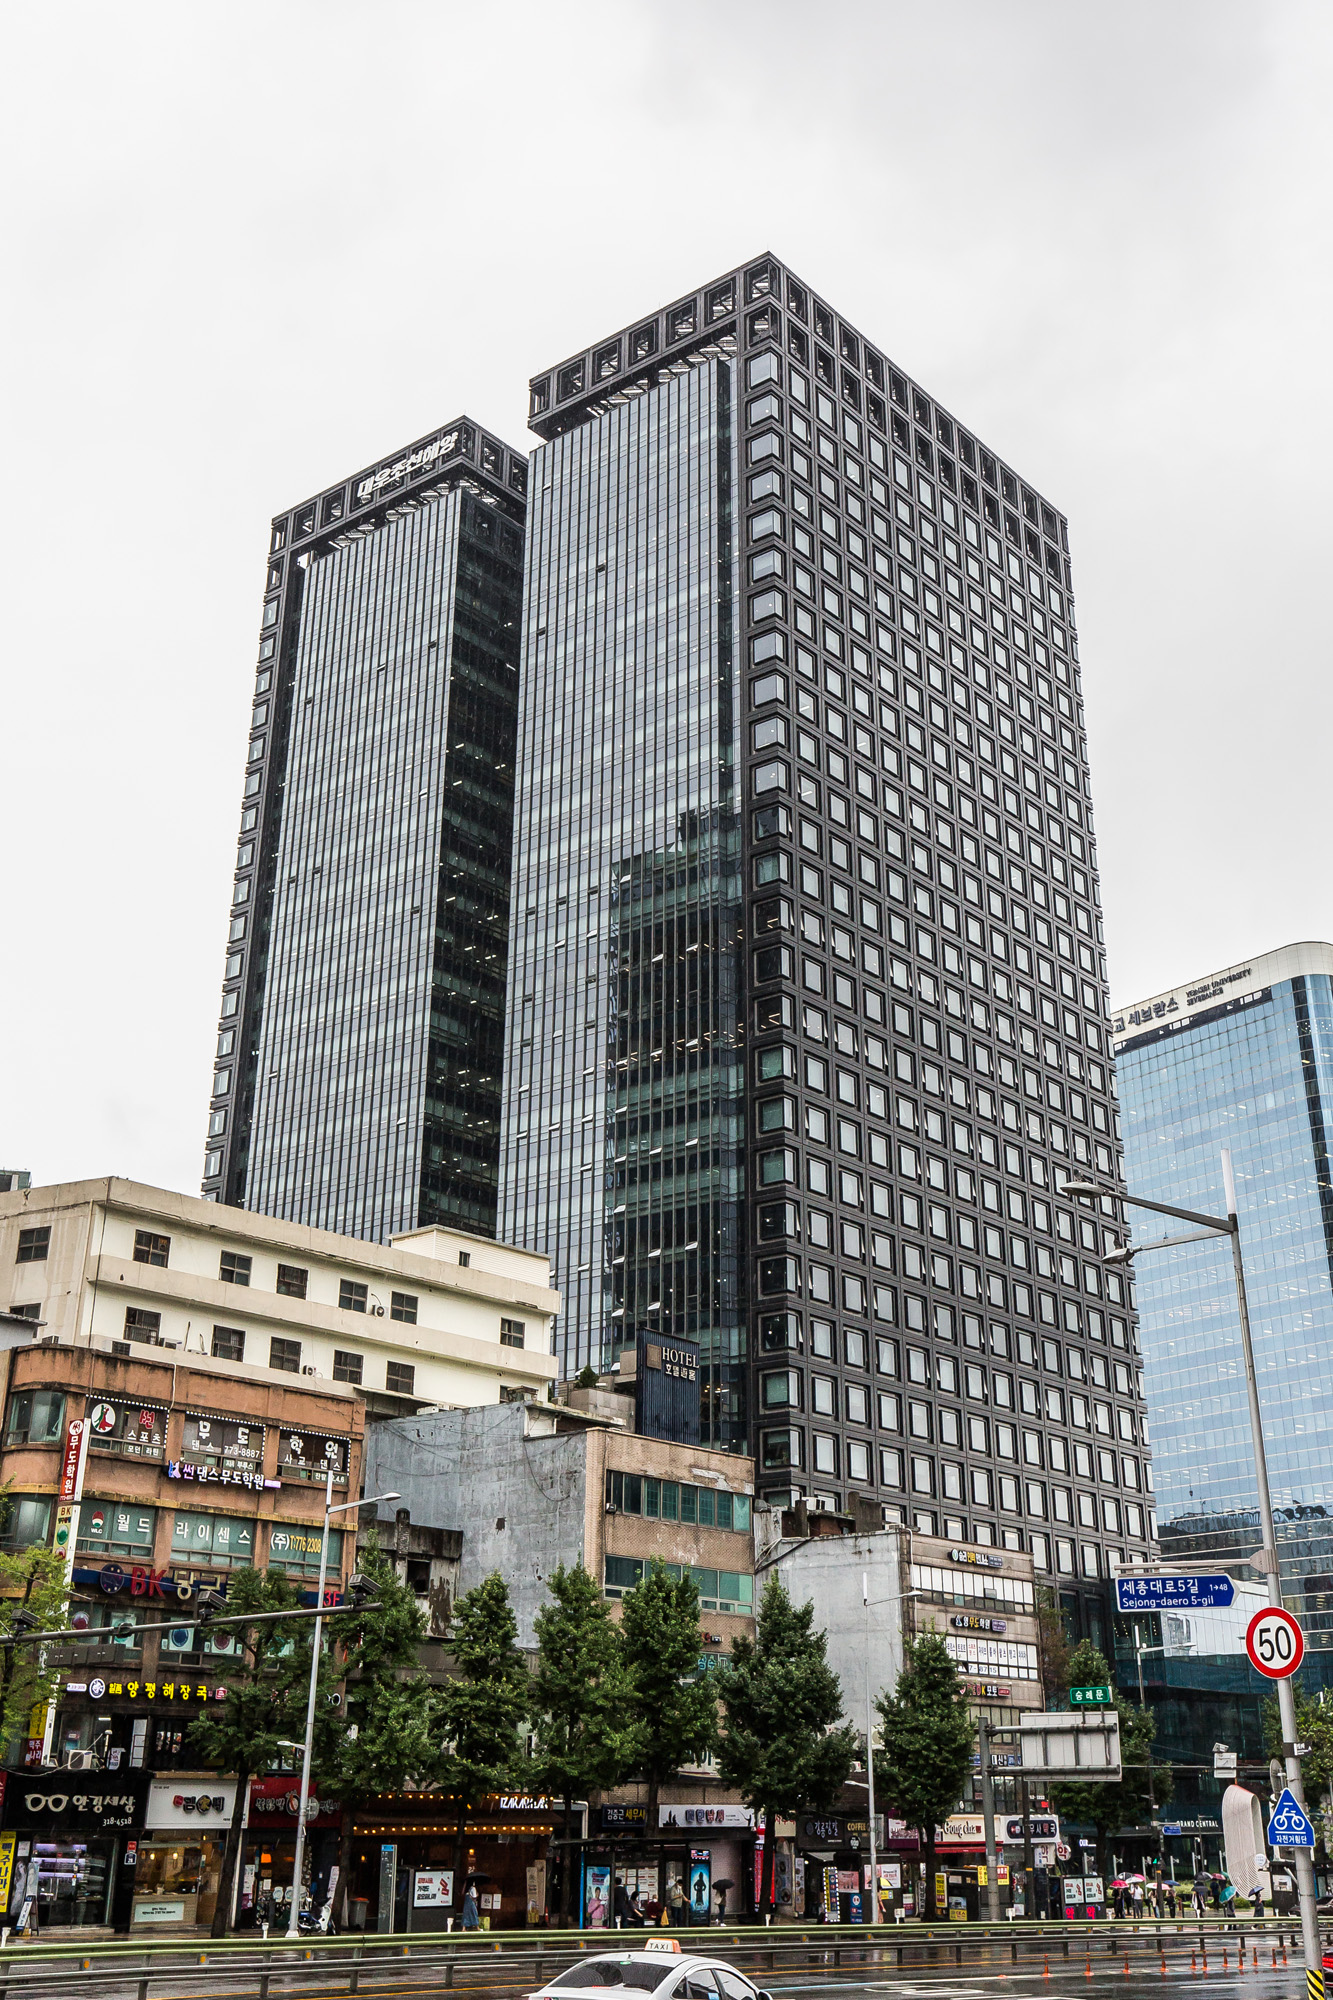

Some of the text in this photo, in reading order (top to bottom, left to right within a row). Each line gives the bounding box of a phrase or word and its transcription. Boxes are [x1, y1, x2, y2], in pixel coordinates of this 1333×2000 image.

[357, 431, 459, 498] 대우조선해양
[1128, 997, 1179, 1026] 세브란스
[662, 1346, 700, 1369] HOTEL
[127, 1429, 341, 1471] 스포츠 댄스 773-8887 사교 댄스
[64, 1435, 79, 1494] 무도학원
[60, 1506, 72, 1516] BK
[117, 1514, 150, 1533] 월드
[175, 1522, 250, 1545] 라이센스
[270, 1532, 290, 1551] (주)
[307, 1538, 322, 1554] 2308
[131, 1566, 168, 1598] BK
[1121, 1578, 1199, 1596] 세종대로5길
[323, 1589, 341, 1607] 3F
[1122, 1595, 1214, 1609] Sejong-daero 5-gil
[1258, 1625, 1292, 1662] 50
[127, 1680, 207, 1701] 양평해장국
[1075, 1689, 1104, 1701] 숭례문
[72, 1795, 136, 1814] 안경세상
[102, 1816, 132, 1827] 318-4518
[625, 1808, 646, 1821] 세무사
[847, 1822, 866, 1832] COFFEE
[1195, 1820, 1219, 1828] CENTRAL
[1275, 1834, 1307, 1844] 자전거횡단
[1057, 1846, 1068, 1860] 약
[649, 1942, 669, 1950] TAXI
